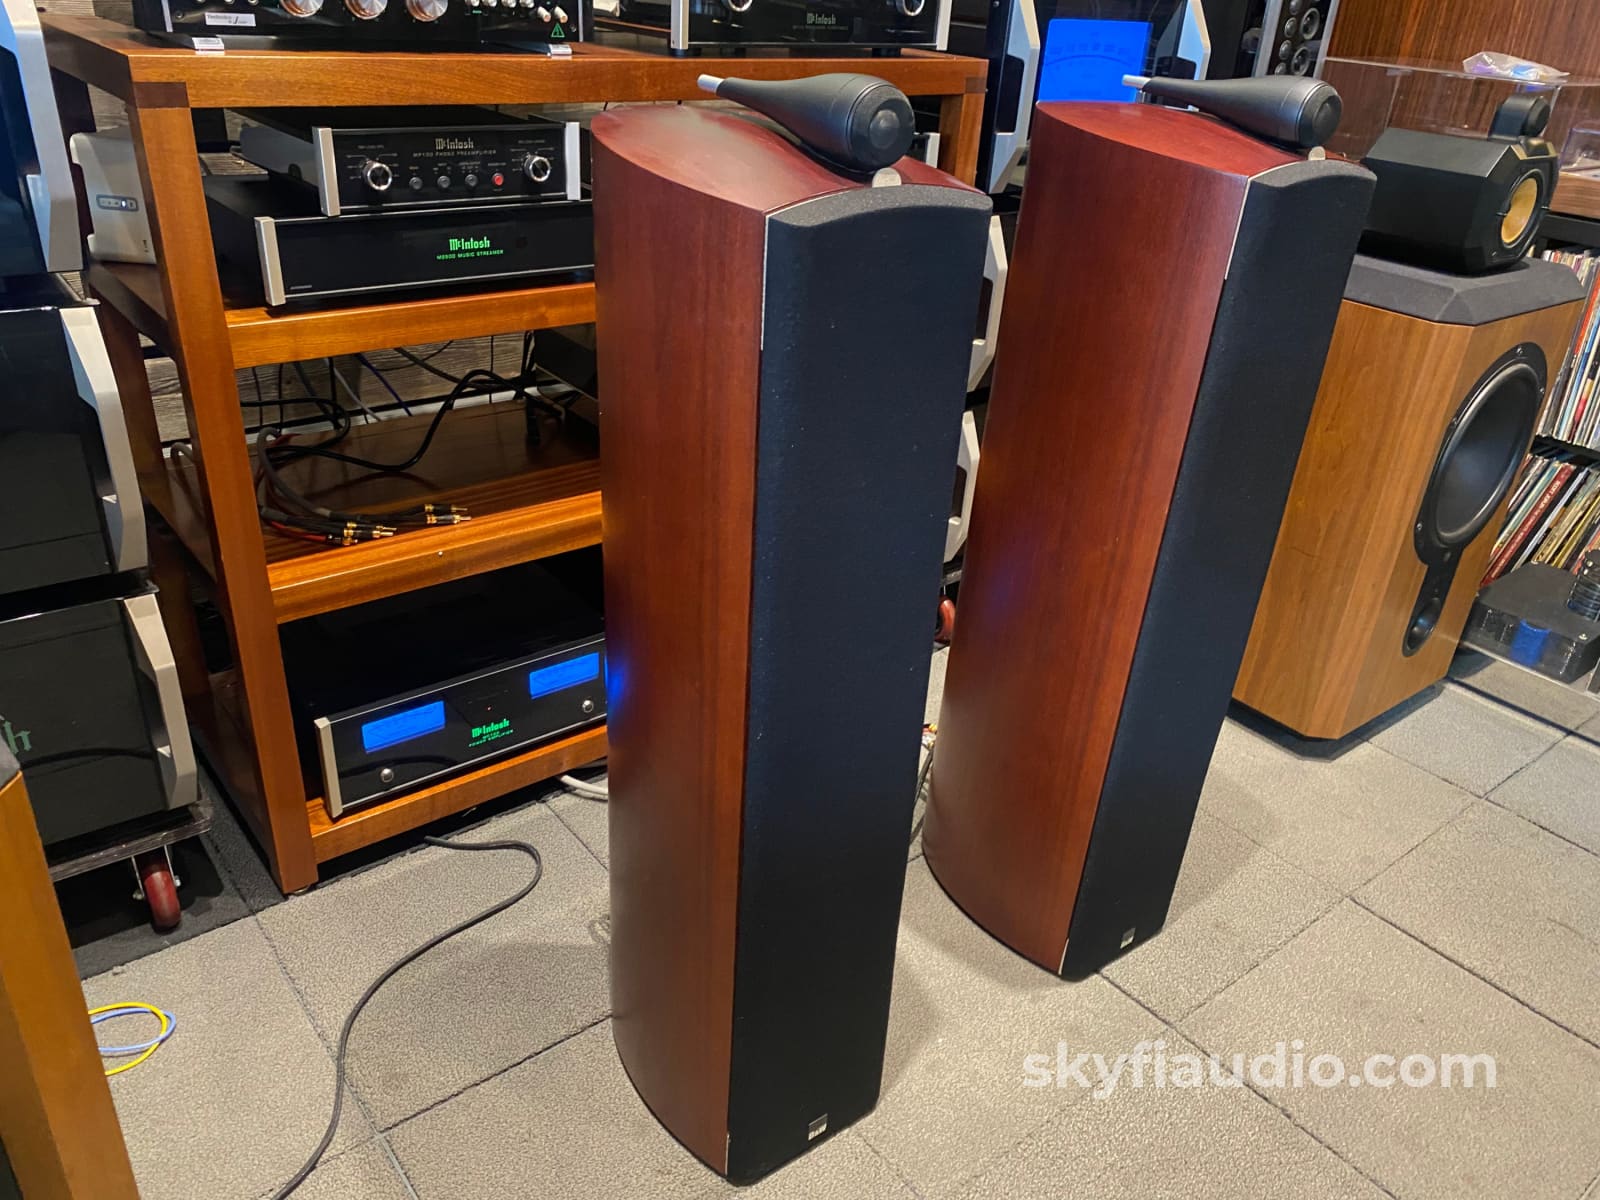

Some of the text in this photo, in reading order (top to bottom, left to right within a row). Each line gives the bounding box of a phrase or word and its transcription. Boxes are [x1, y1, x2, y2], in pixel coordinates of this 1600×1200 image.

[435, 137, 474, 150] McIntosh
[448, 236, 490, 251] McIntosh
[472, 718, 510, 738] McIntosh
